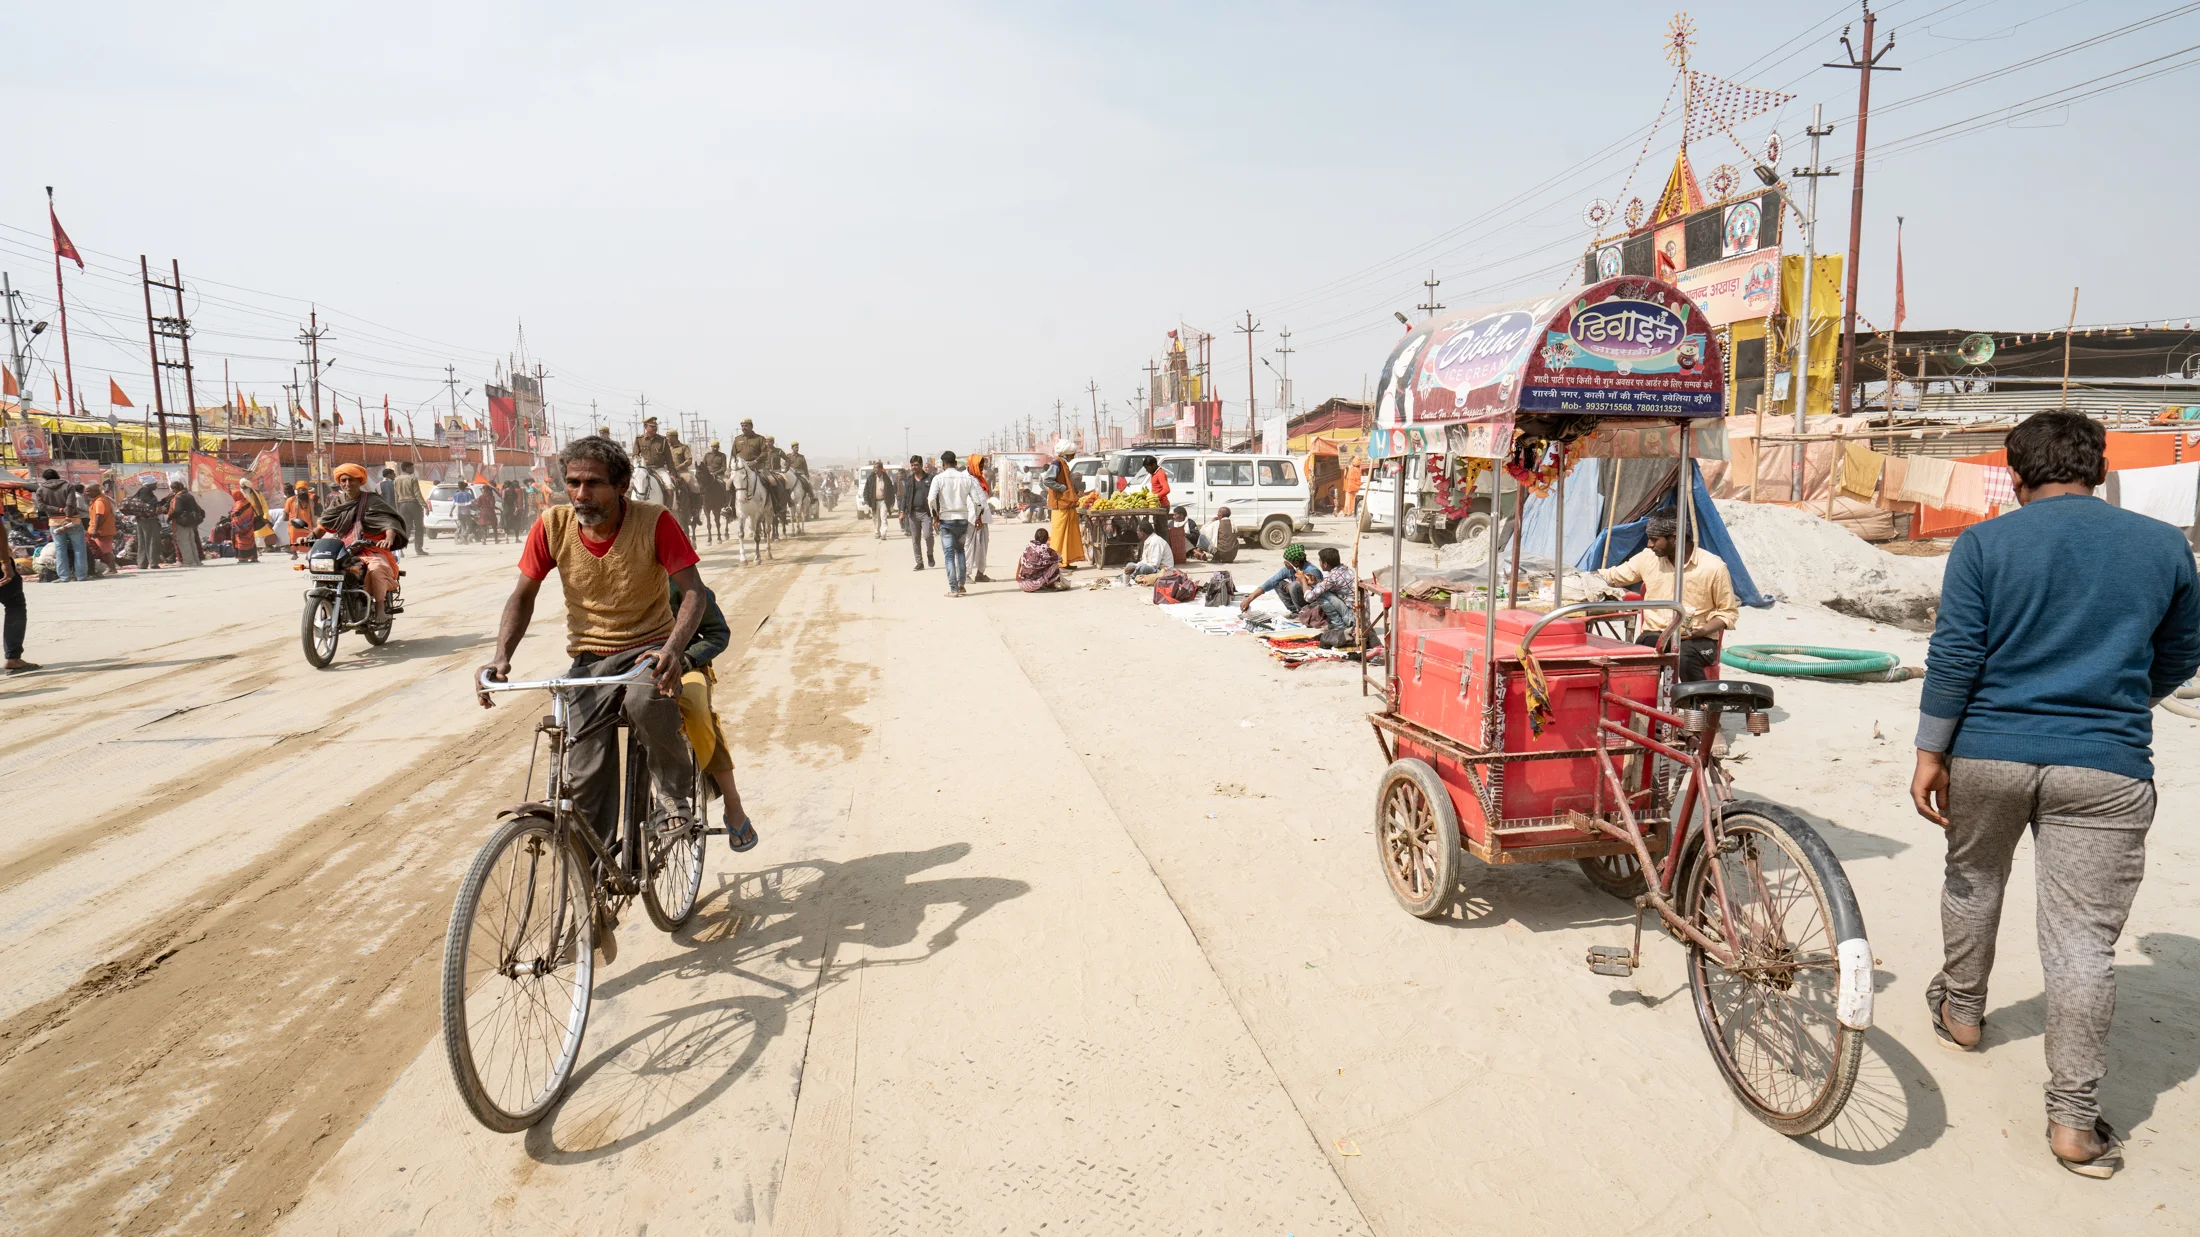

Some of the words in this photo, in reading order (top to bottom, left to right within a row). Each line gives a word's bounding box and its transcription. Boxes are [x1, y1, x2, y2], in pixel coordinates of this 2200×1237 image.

[1710, 277, 1740, 297] अखाड़ा
[1577, 310, 1678, 348] डिवाइन
[1439, 327, 1526, 370] Divine
[1444, 368, 1462, 381] ICE
[1465, 355, 1509, 381] CREAM
[1534, 374, 1549, 384] शादी
[1577, 374, 1592, 385] किसी
[1615, 378, 1633, 386] अवसर
[1663, 378, 1669, 387] के
[1670, 379, 1682, 389] लिए
[1532, 388, 1557, 398] शास्त्री
[1560, 391, 1581, 399] नगर,
[1584, 390, 1605, 399] काली
[1620, 391, 1630, 399] की
[1662, 393, 1691, 402] हवेलिया
[1637, 404, 1682, 412] 7800313523
